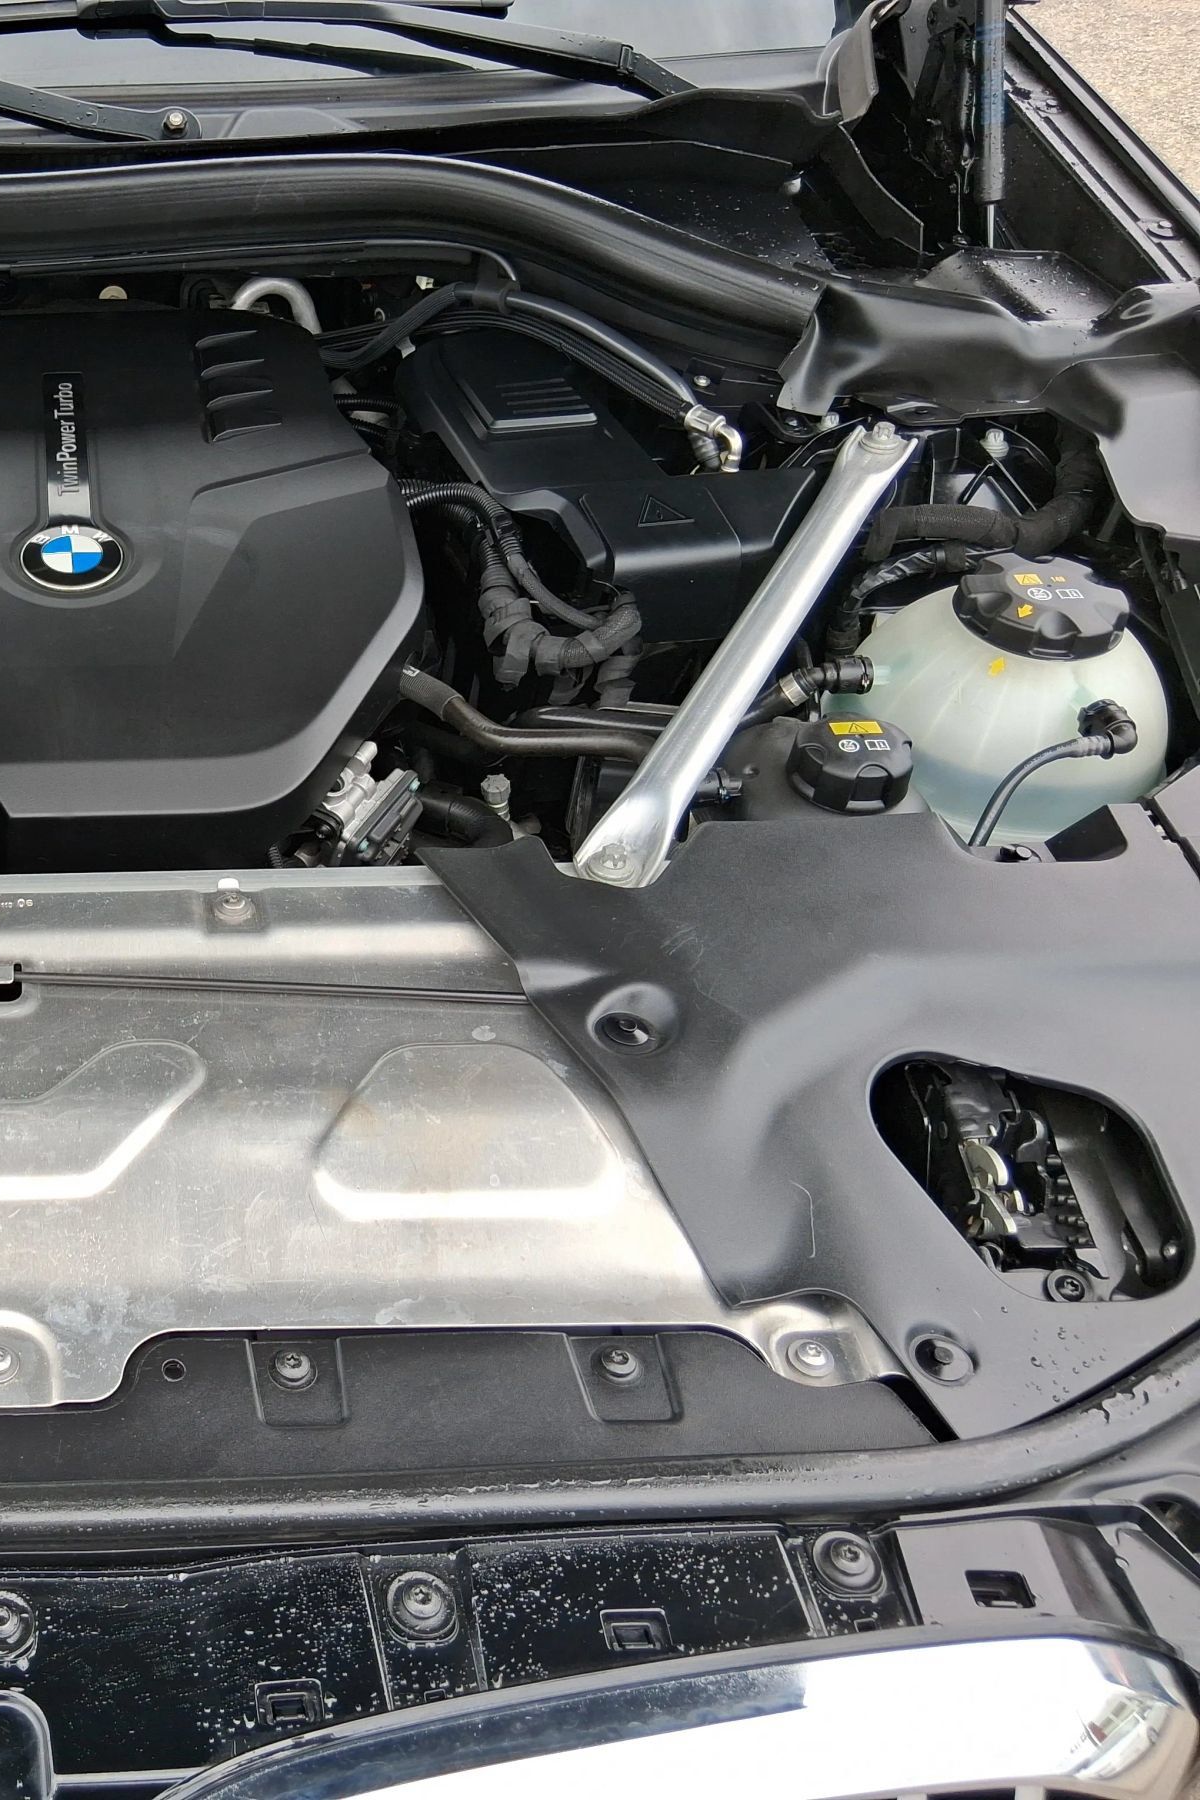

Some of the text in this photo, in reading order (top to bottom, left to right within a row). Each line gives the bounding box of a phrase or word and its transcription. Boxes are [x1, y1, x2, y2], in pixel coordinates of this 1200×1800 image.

[53, 382, 80, 496] TwinPower Turbo
[31, 524, 113, 545] BMW
